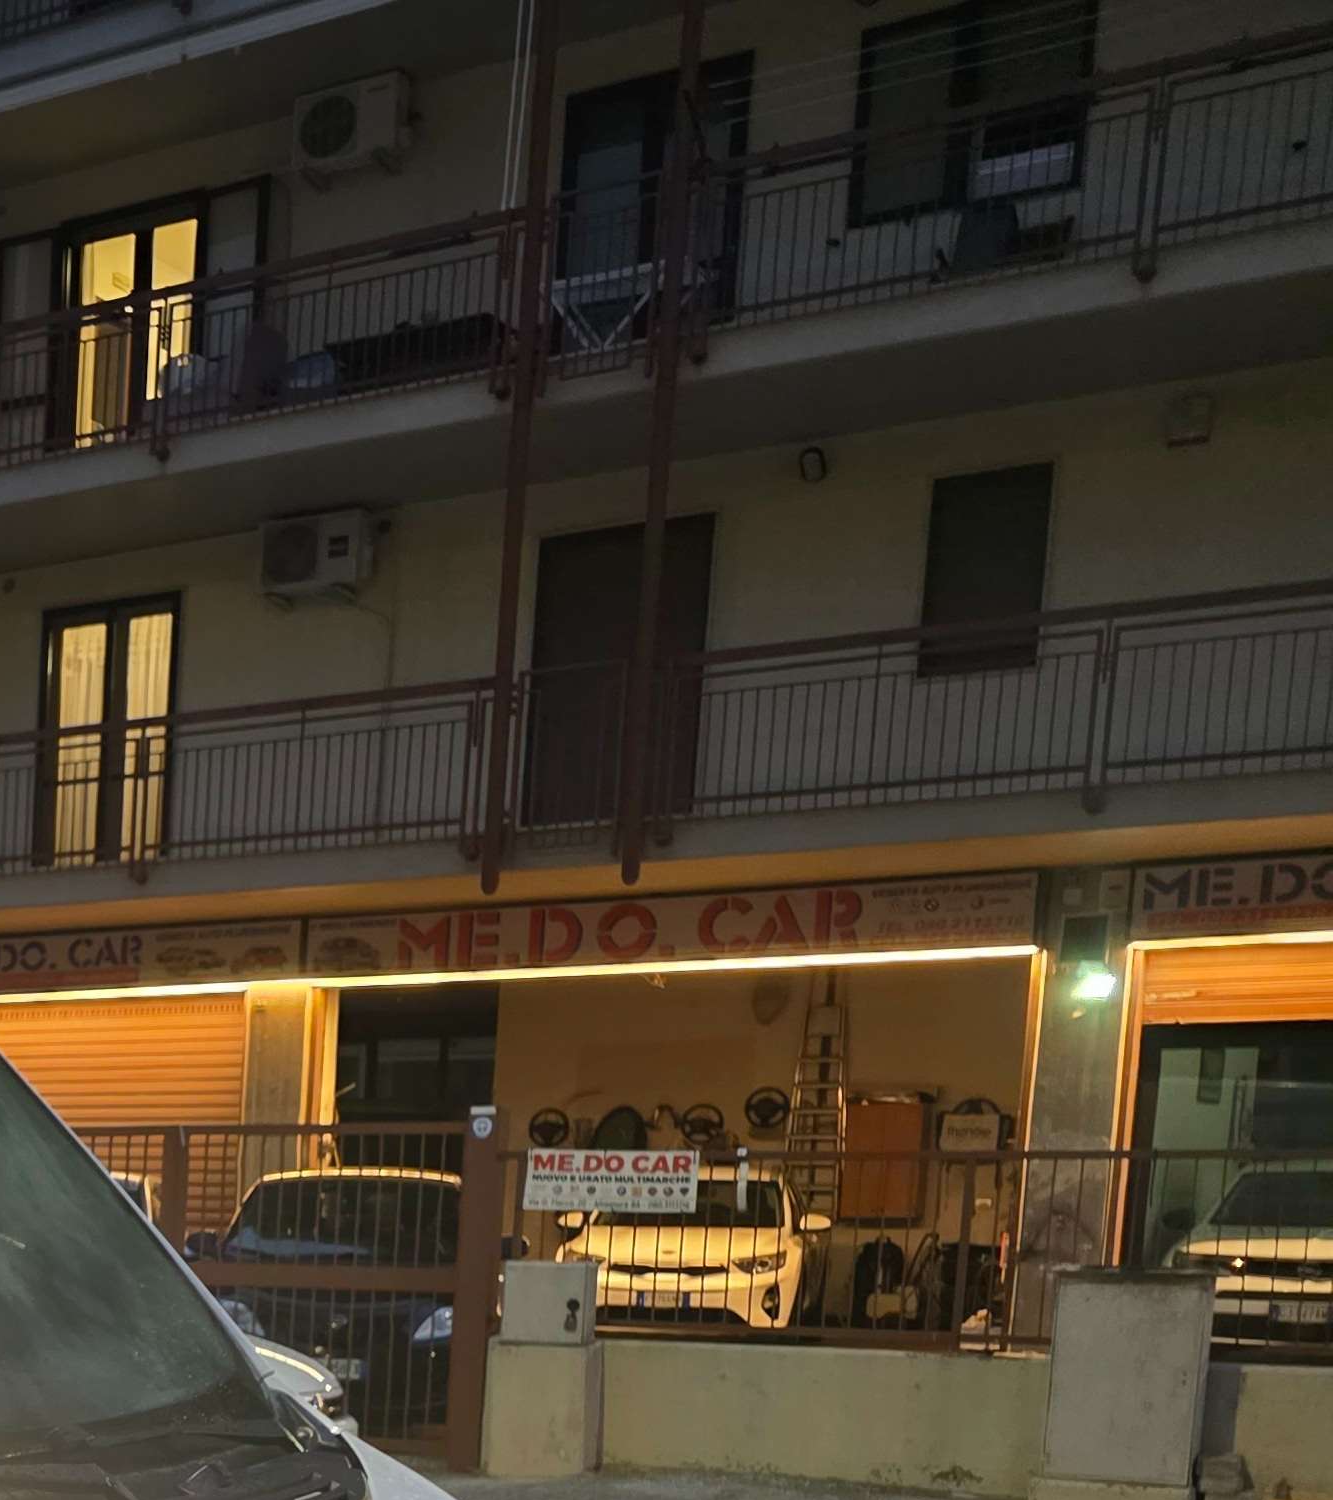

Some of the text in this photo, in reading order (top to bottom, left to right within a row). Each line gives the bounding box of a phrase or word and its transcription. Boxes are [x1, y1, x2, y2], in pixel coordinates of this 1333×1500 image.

[696, 888, 864, 953] CAR
[67, 934, 144, 968] CAR
[533, 1153, 692, 1173] ME.DO CAR
[532, 1174, 567, 1182] NUOVO
[579, 1175, 613, 1184] USATO
[614, 1175, 691, 1184] MULTIMARCHE
